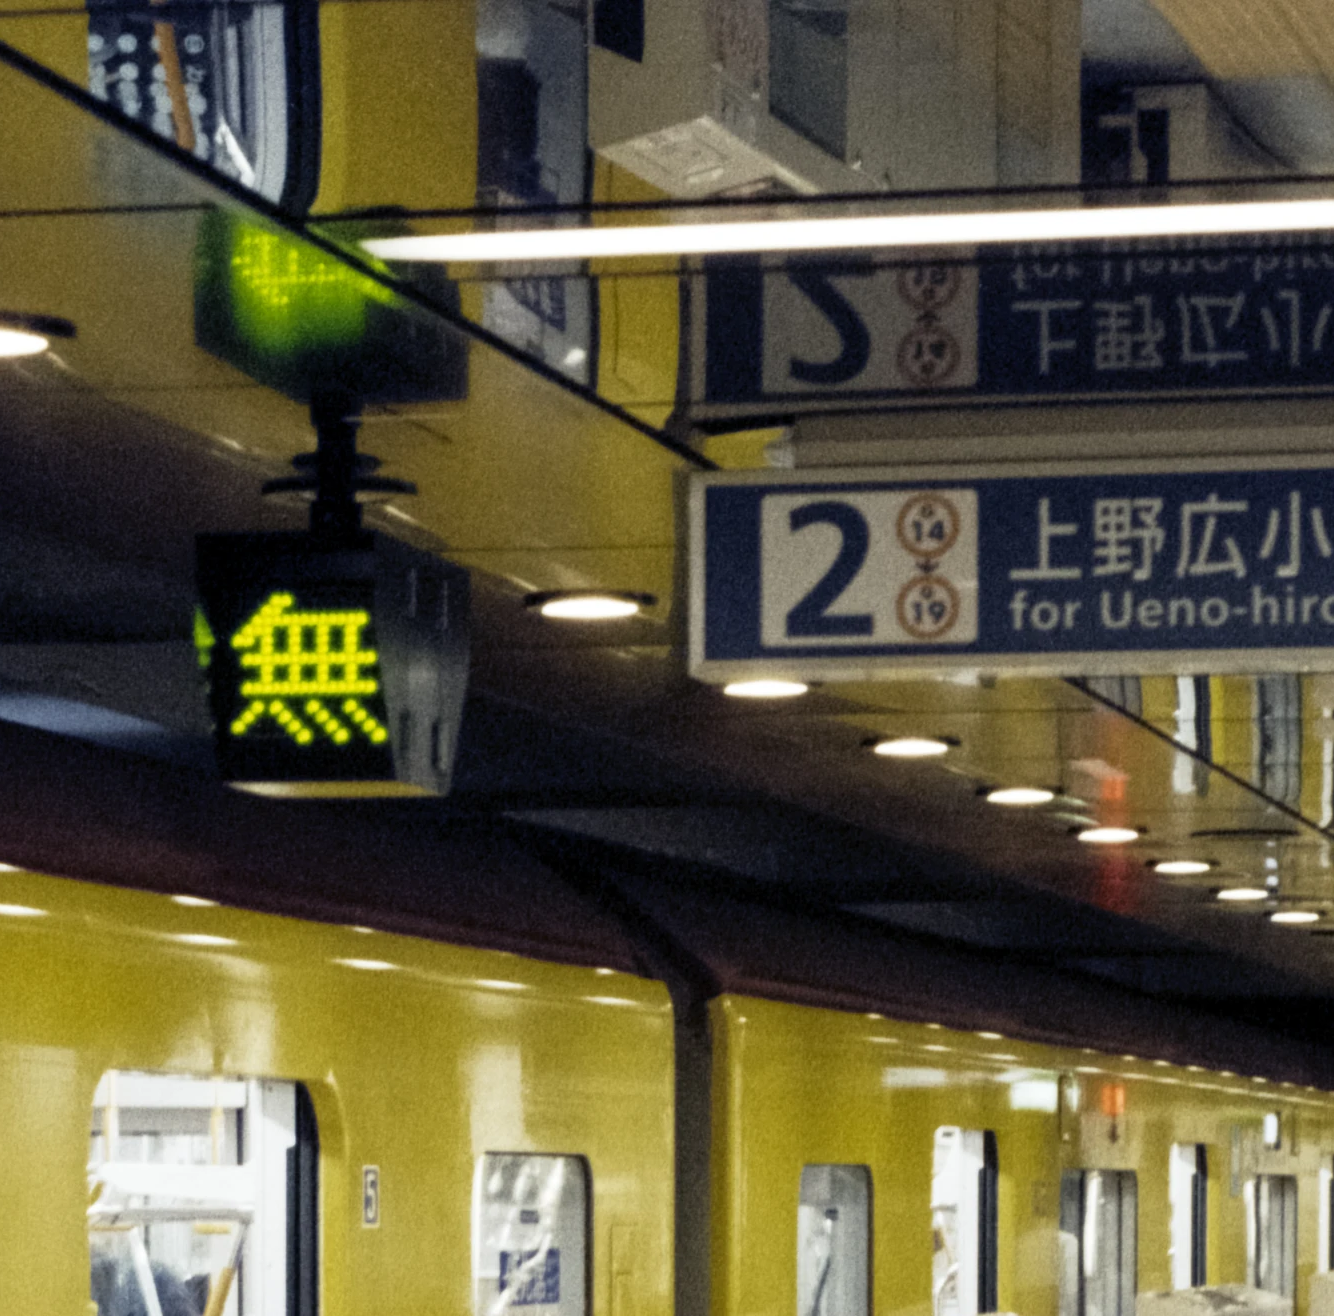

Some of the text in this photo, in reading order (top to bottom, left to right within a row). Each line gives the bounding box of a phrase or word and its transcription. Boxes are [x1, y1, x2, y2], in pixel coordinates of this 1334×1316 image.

[912, 519, 946, 542] 14
[785, 500, 874, 637] 2
[913, 601, 947, 625] 19
[1010, 590, 1080, 630] for
